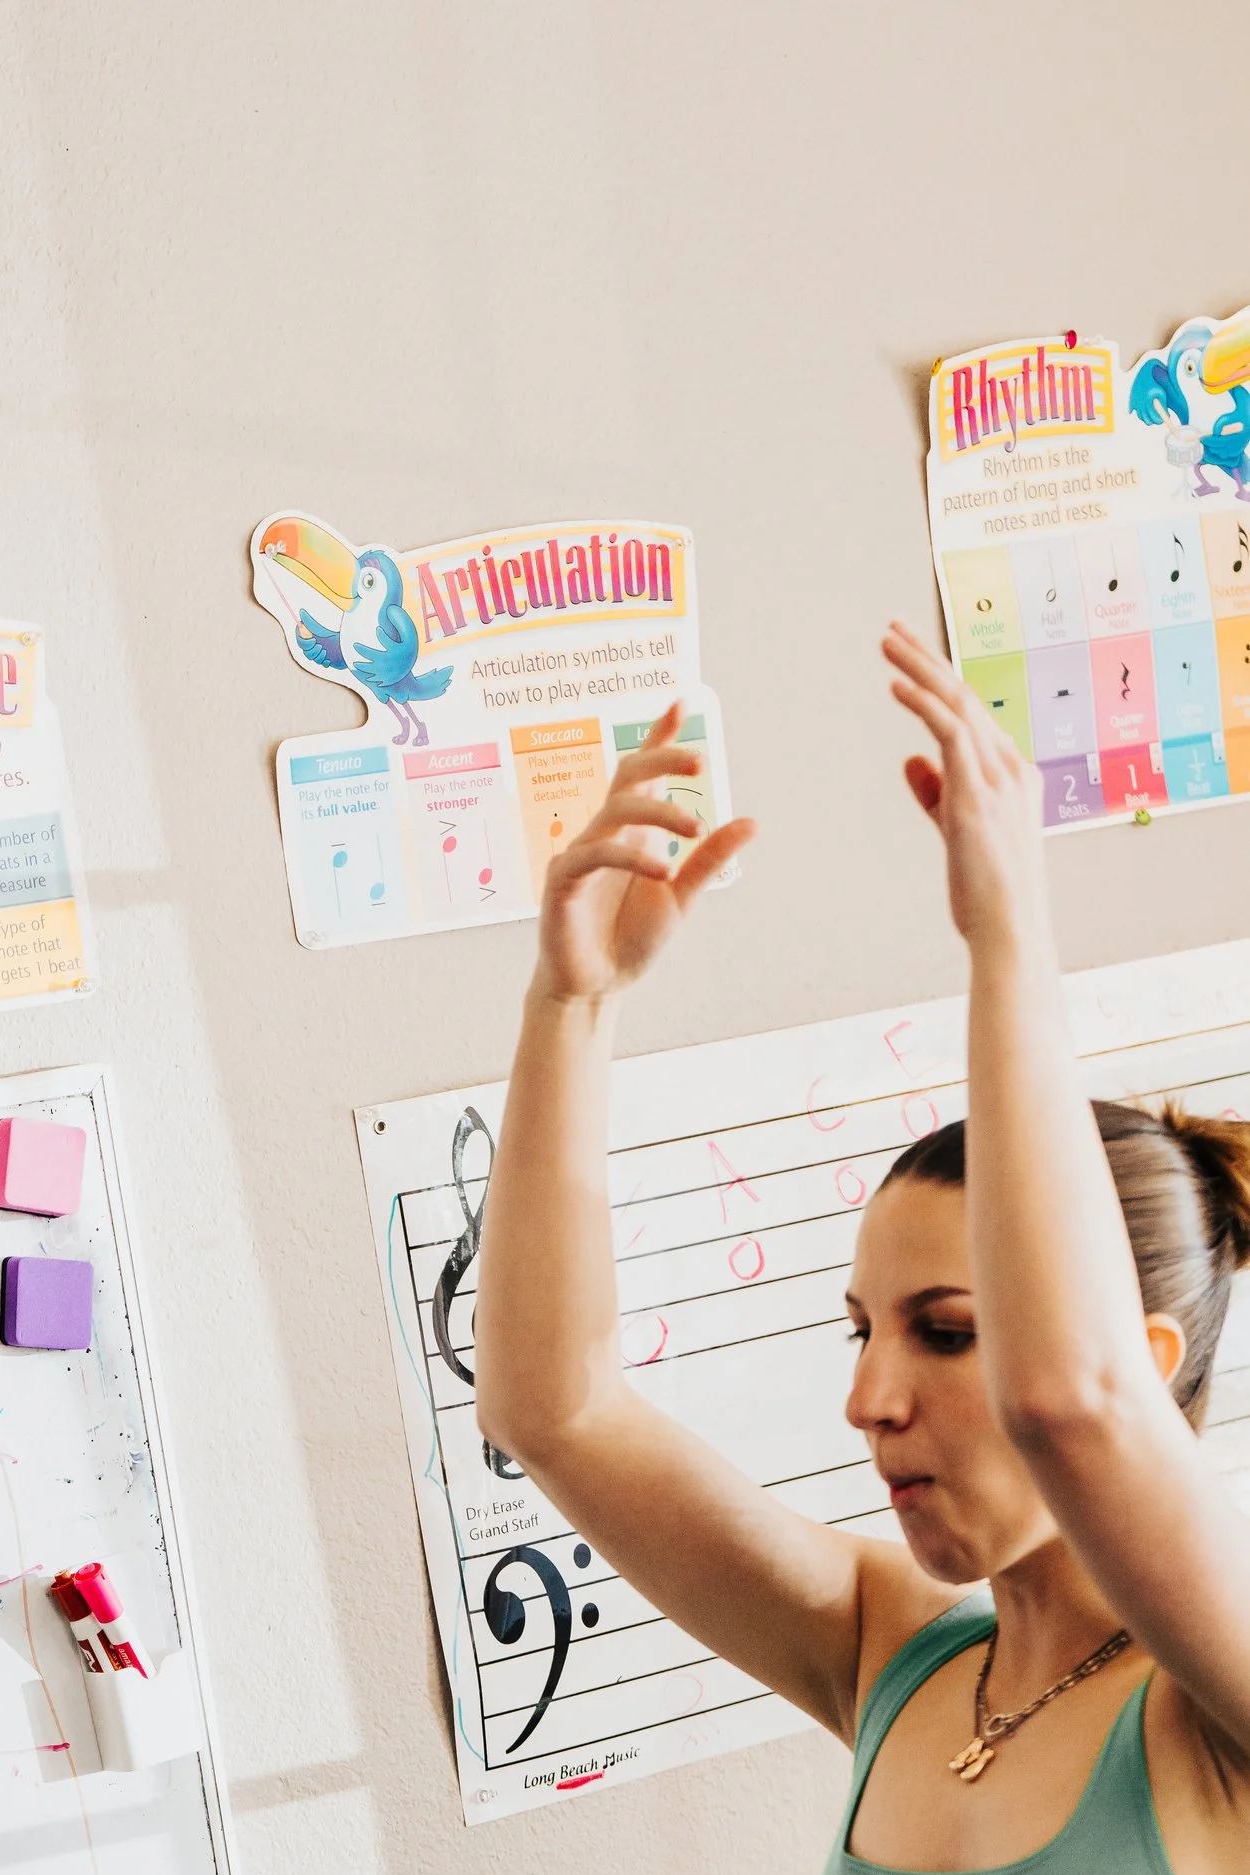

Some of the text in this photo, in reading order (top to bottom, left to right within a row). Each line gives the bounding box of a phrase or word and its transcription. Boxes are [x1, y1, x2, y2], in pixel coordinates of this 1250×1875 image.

[953, 346, 1096, 453] Rhythm
[982, 446, 1092, 478] Rhythm is the
[943, 468, 1137, 516] pattern of long and short
[983, 516, 1027, 535] notes
[1032, 508, 1062, 527] and
[415, 533, 673, 642] Articulation
[1093, 600, 1138, 619] Quarter
[1160, 591, 1197, 609] Eighth
[1040, 609, 1065, 627] Half
[1107, 618, 1130, 630] Note
[969, 620, 1006, 638] Whole
[1045, 627, 1067, 639] Note
[980, 638, 1004, 650] Note
[471, 635, 675, 680] Articulation symbols tell
[483, 668, 676, 708] how to play each note.
[530, 727, 584, 745] Staccato
[316, 755, 362, 774] Tenuto
[428, 750, 474, 770] Accent
[528, 750, 593, 768] Play the note
[531, 766, 595, 785] shorter and
[1126, 763, 1139, 791] 1
[299, 779, 390, 803] Play the note for
[423, 776, 494, 796] Play the note
[534, 786, 583, 802] detached.
[1062, 774, 1079, 802] 2
[1124, 791, 1150, 808] Beat
[317, 803, 339, 818] full
[1058, 803, 1091, 820] Beats
[40, 824, 57, 841] of
[24, 853, 38, 868] in
[43, 853, 52, 865] a
[31, 914, 46, 931] of
[33, 937, 62, 954] that
[0, 956, 81, 985] gets beat
[465, 1498, 526, 1522] Dry Erase
[469, 1512, 540, 1541] Grand Staff
[523, 1746, 641, 1790] Long Beach Music
